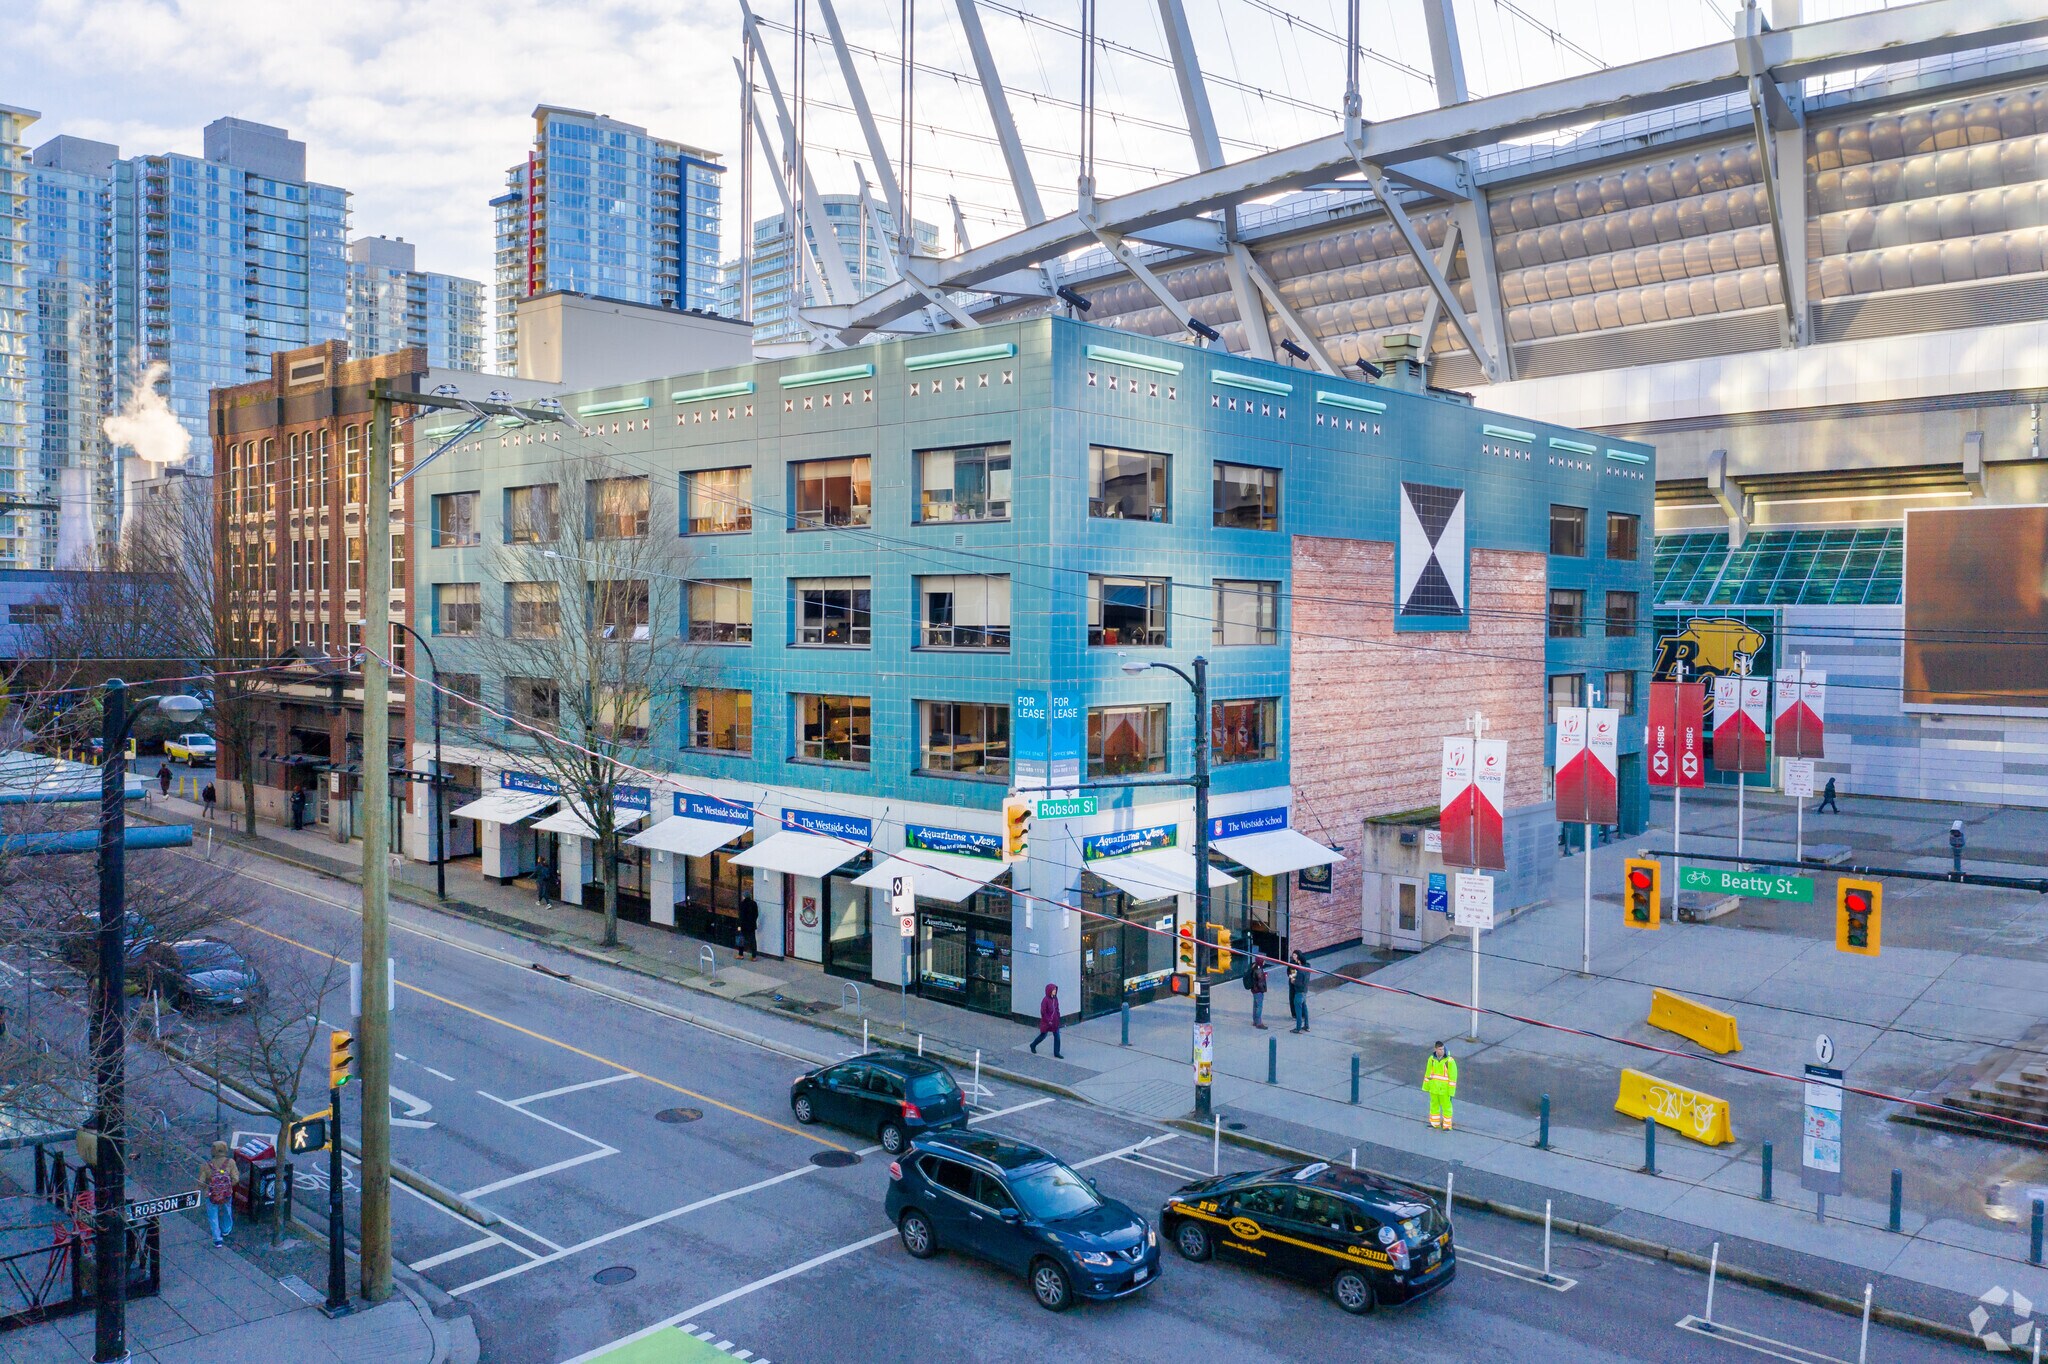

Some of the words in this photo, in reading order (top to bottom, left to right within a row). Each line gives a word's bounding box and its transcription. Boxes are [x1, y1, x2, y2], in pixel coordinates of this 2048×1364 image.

[1017, 696, 1035, 707] FOR
[1053, 697, 1069, 707] FOR
[1017, 708, 1045, 719] LEASE
[1053, 708, 1078, 719] LEASE
[1657, 725, 1665, 748] HSBC
[630, 795, 647, 805] School
[1041, 803, 1080, 816] Robson
[1083, 800, 1094, 813] St
[692, 803, 703, 814] The
[704, 805, 729, 817] Westside
[729, 808, 749, 820] School
[801, 818, 814, 829] The
[815, 819, 844, 832] Westside
[845, 823, 868, 836] School
[1228, 822, 1239, 832] The
[1241, 818, 1264, 829] Westside
[1264, 815, 1283, 826] School
[918, 828, 966, 841] Aquariums
[970, 835, 997, 846] West
[1095, 832, 1140, 847] Aquariums
[1142, 828, 1165, 840] West
[1721, 873, 1773, 895] Beatty
[1776, 878, 1798, 895] St.
[135, 1198, 178, 1217] ROBSON
